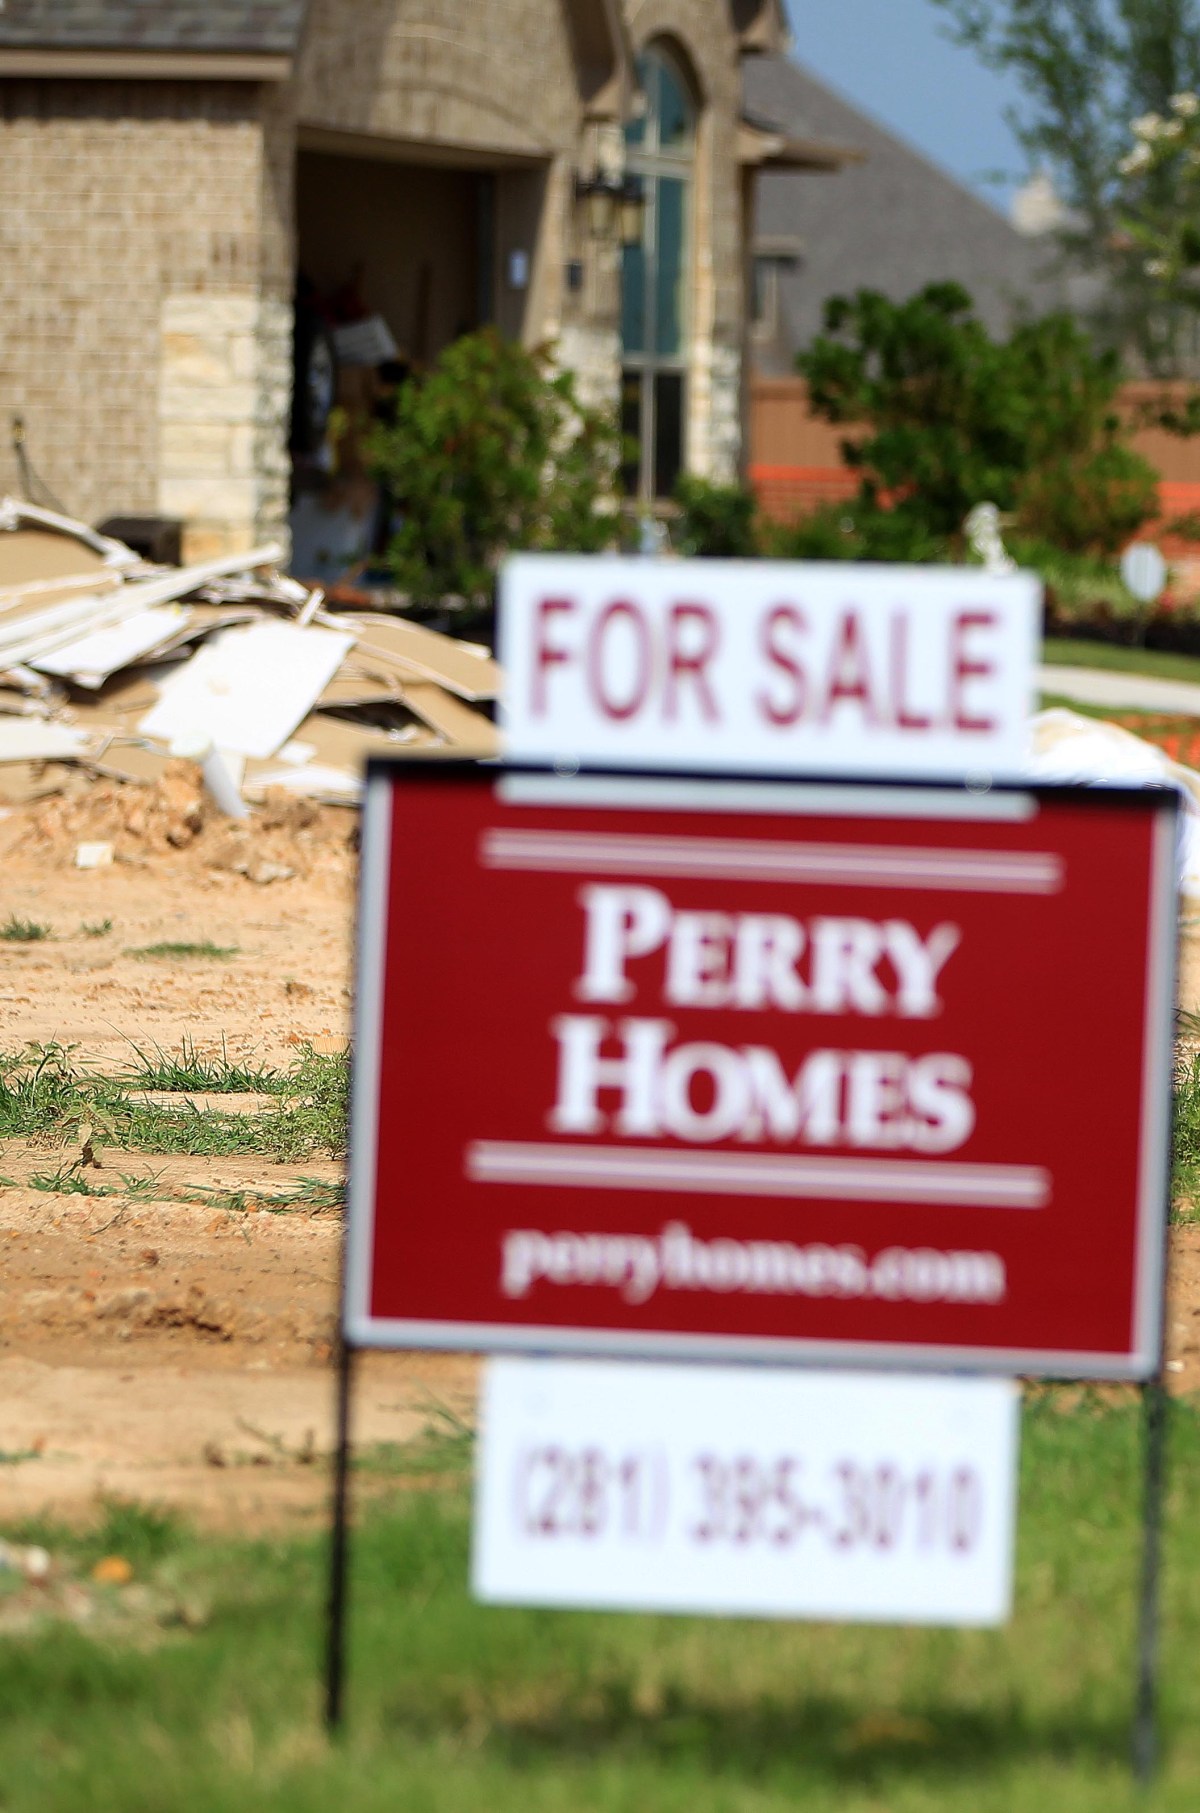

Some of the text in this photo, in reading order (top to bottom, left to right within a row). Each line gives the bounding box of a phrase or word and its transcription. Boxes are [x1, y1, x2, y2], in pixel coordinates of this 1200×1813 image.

[528, 596, 1002, 734] FOR SALE
[573, 881, 961, 1020] PERRY
[547, 1012, 976, 1154] HOMES
[498, 1221, 1006, 1306] perryhomes.com
